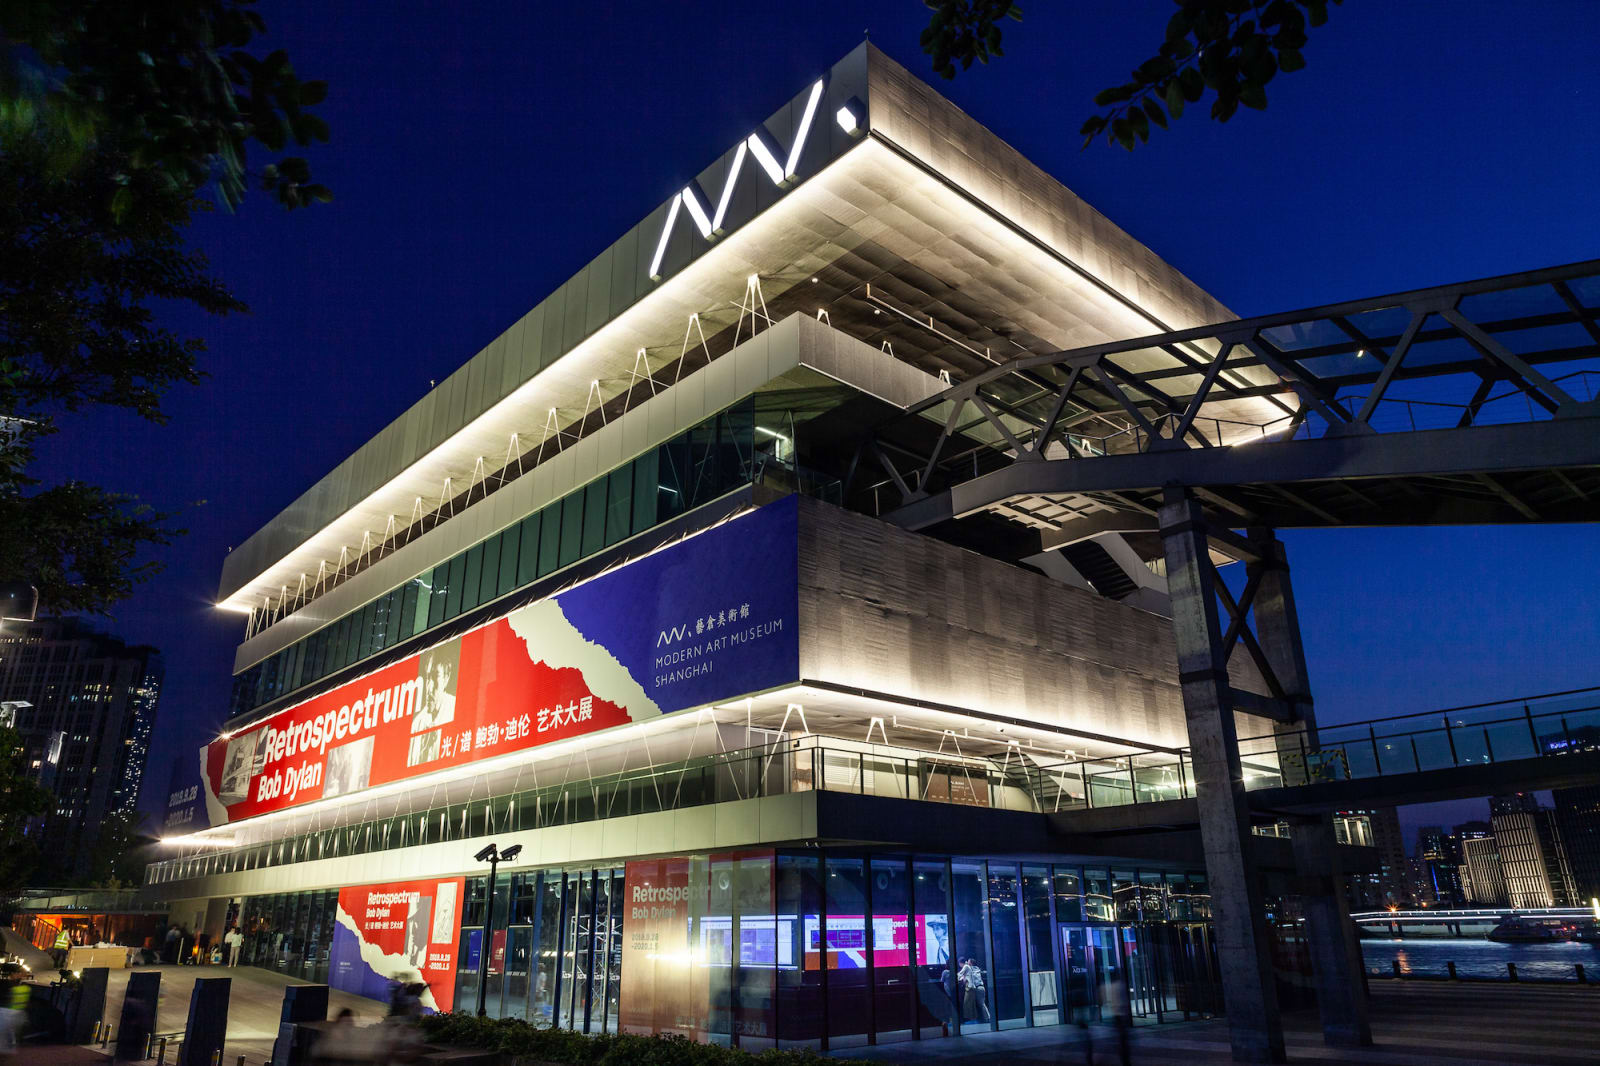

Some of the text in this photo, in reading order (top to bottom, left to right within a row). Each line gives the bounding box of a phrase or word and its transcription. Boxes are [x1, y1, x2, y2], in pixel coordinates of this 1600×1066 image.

[655, 619, 783, 669] MODERN ART MUSEUM
[655, 661, 713, 688] SHANGHAI
[263, 676, 424, 765] Retrospectrum
[537, 696, 593, 733] 艺术大展
[257, 760, 323, 803] Bob Dylan
[631, 905, 649, 920] Bob
